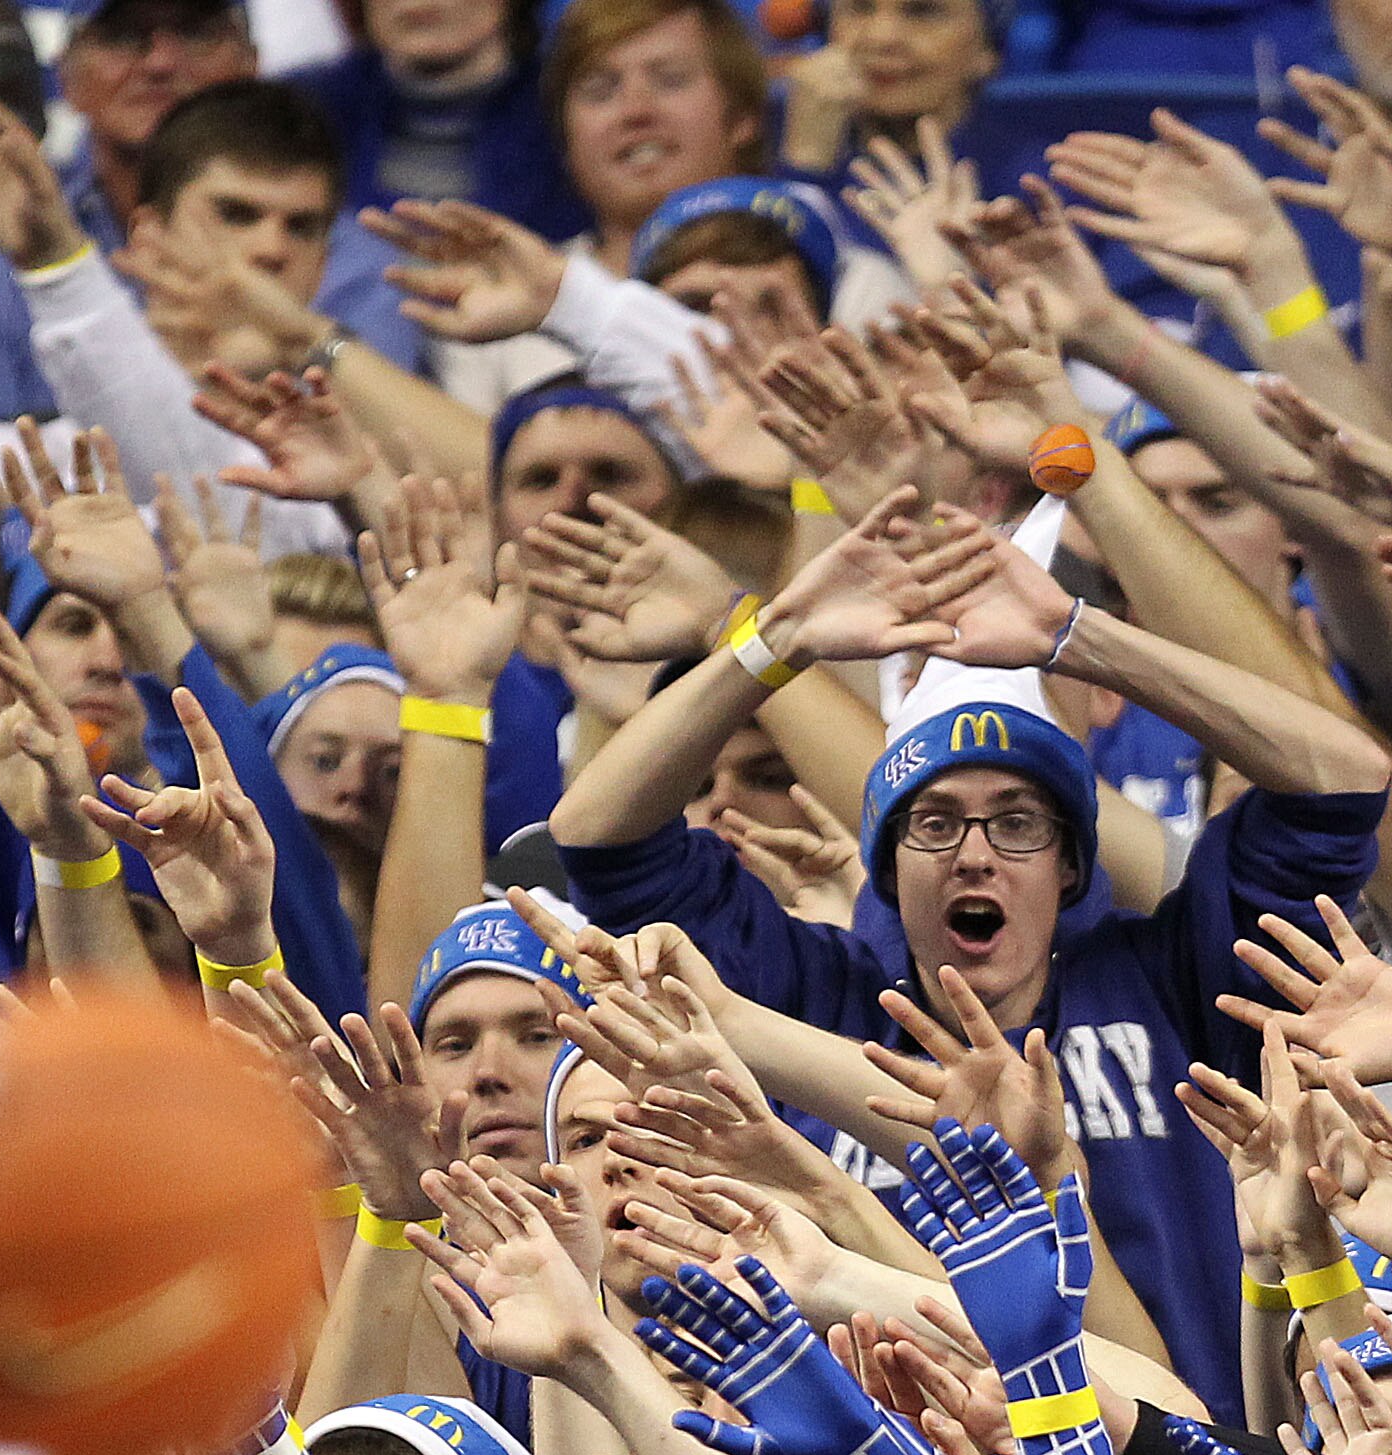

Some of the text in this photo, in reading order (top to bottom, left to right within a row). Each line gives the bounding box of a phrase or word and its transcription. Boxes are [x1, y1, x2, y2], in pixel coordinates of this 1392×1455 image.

[885, 737, 929, 789] UK
[457, 918, 521, 952] UK
[1053, 1021, 1167, 1140] KY
